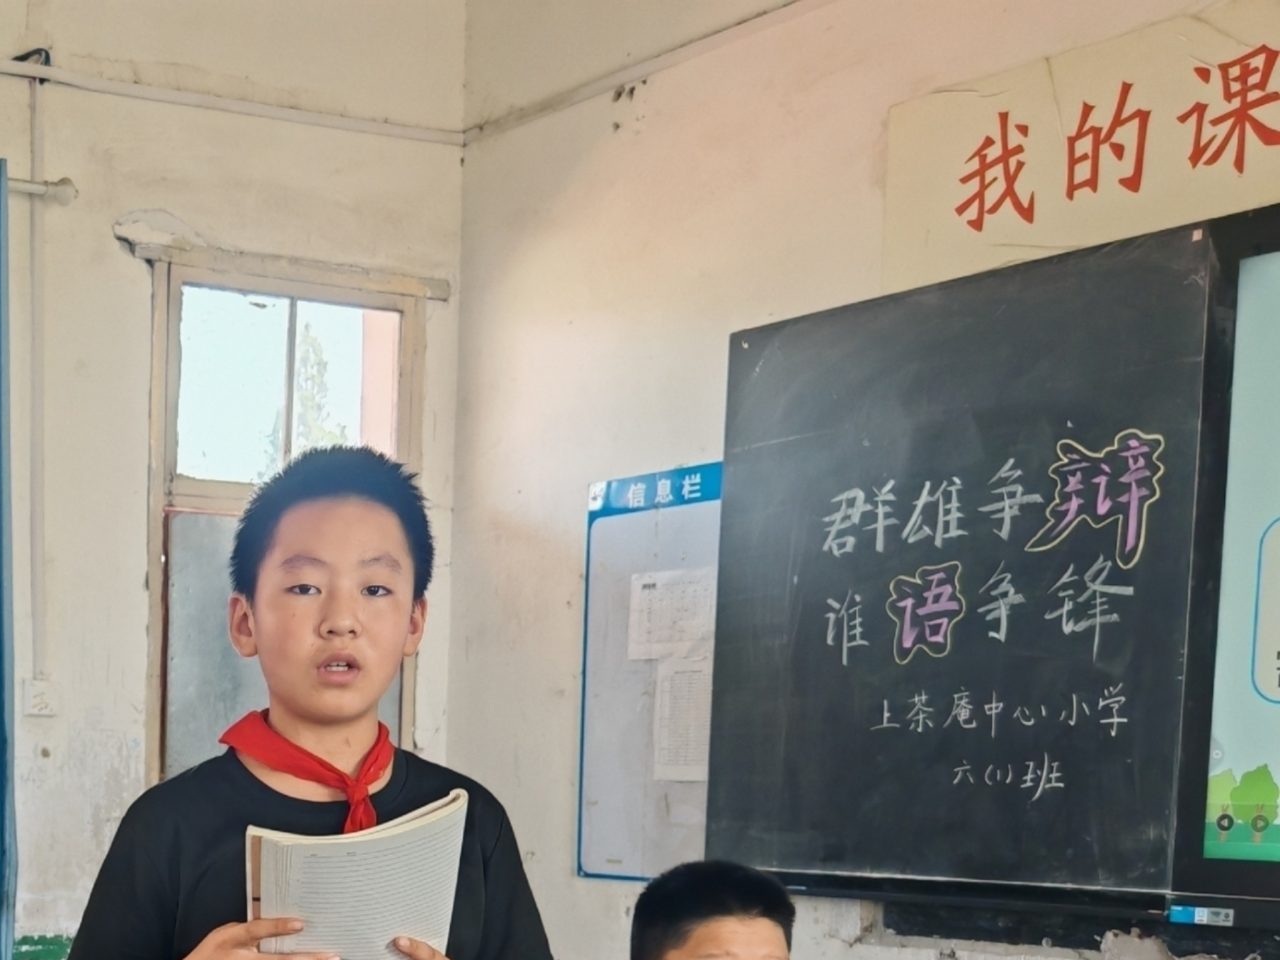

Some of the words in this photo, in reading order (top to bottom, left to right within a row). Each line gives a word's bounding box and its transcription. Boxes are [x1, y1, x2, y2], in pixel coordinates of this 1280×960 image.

[627, 472, 703, 508] 信息栏
[822, 438, 1156, 557] 群雄争辩
[824, 554, 1134, 665] 谁语争锋
[870, 684, 1128, 738] 上茶庵中心小学
